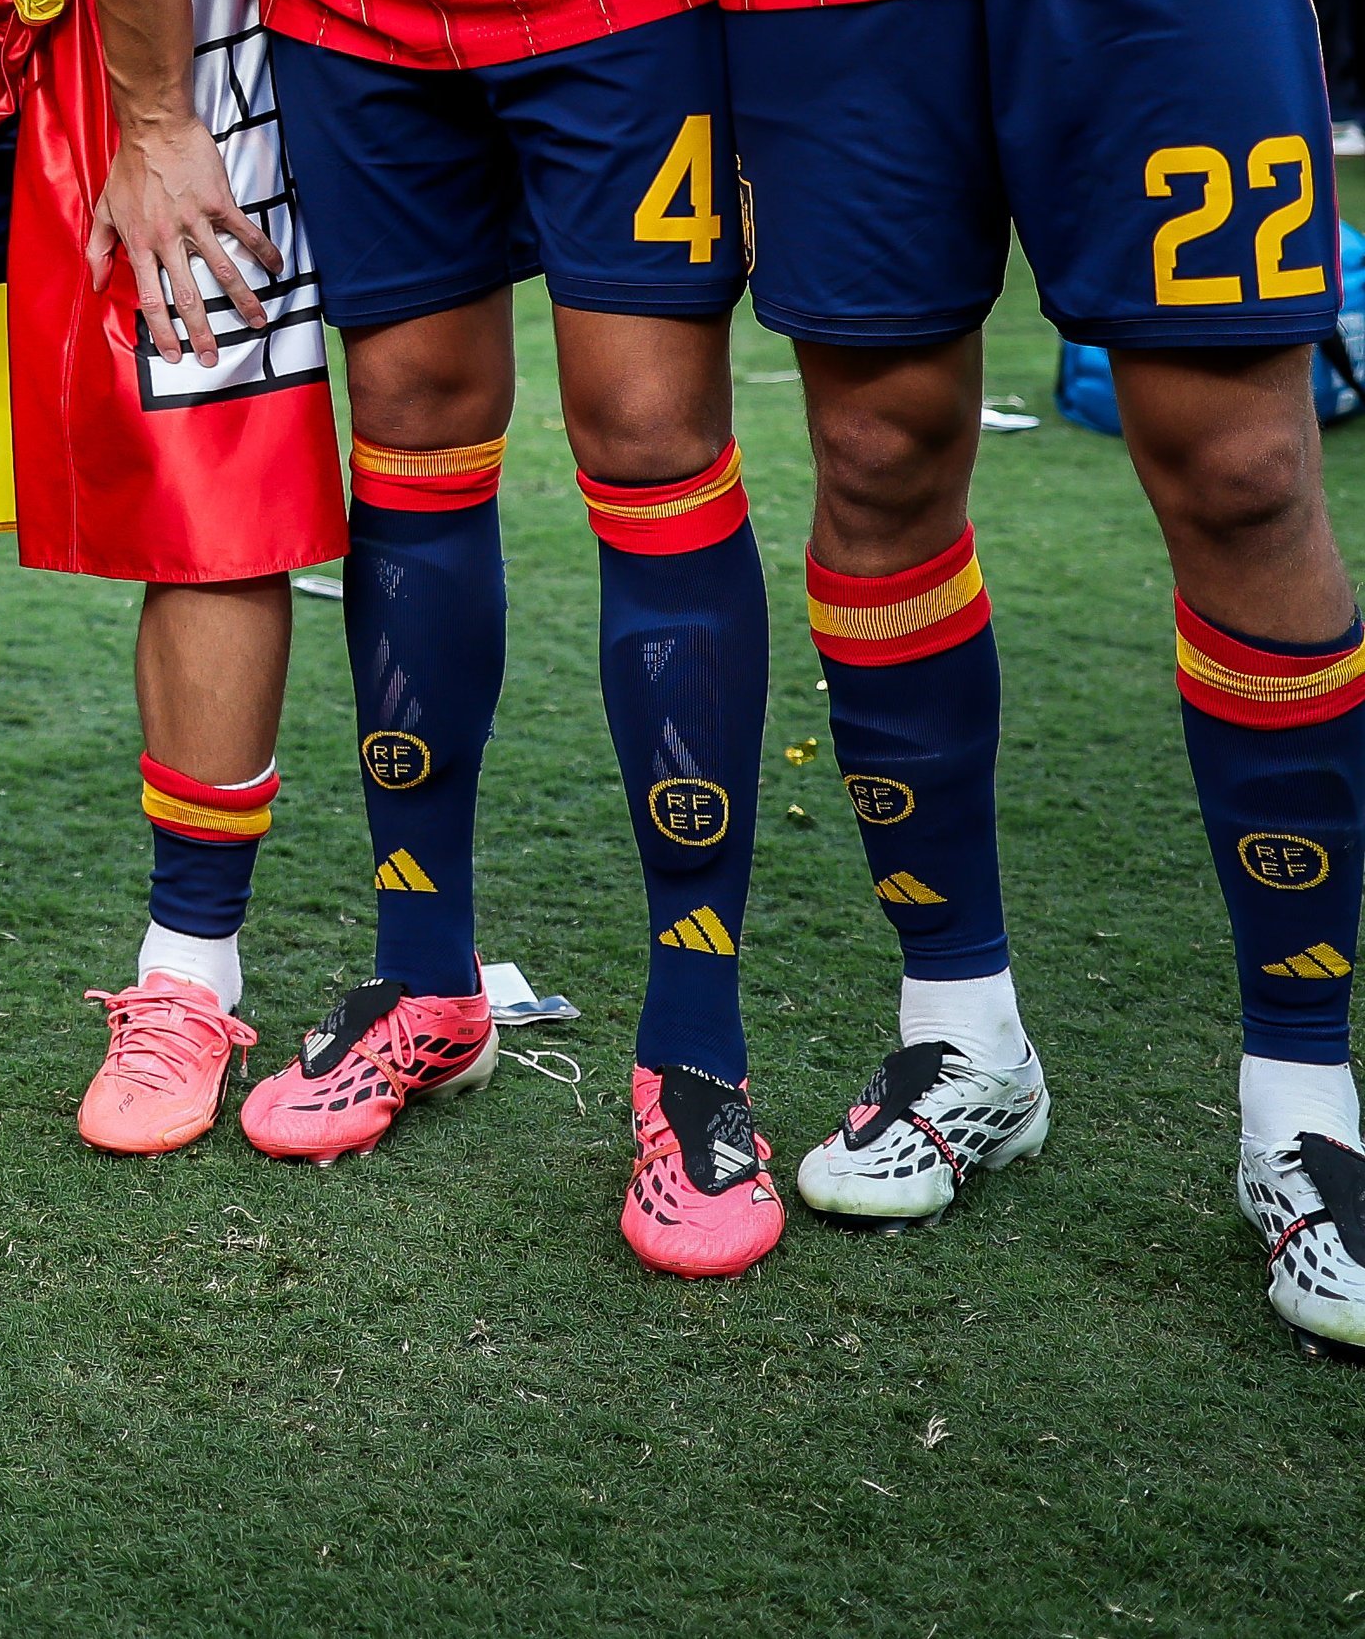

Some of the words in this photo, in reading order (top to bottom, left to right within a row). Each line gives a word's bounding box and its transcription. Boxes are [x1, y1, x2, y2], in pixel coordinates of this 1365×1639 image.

[633, 114, 721, 264] 4
[1144, 135, 1327, 306] 22
[373, 744, 412, 760] RF
[375, 762, 412, 778] EF
[854, 784, 891, 799] RF
[667, 792, 712, 811] RF
[857, 797, 894, 814] EF
[669, 812, 713, 831] EF
[1255, 844, 1305, 862] RF
[1260, 860, 1308, 877] EF
[118, 1092, 135, 1114] F50
